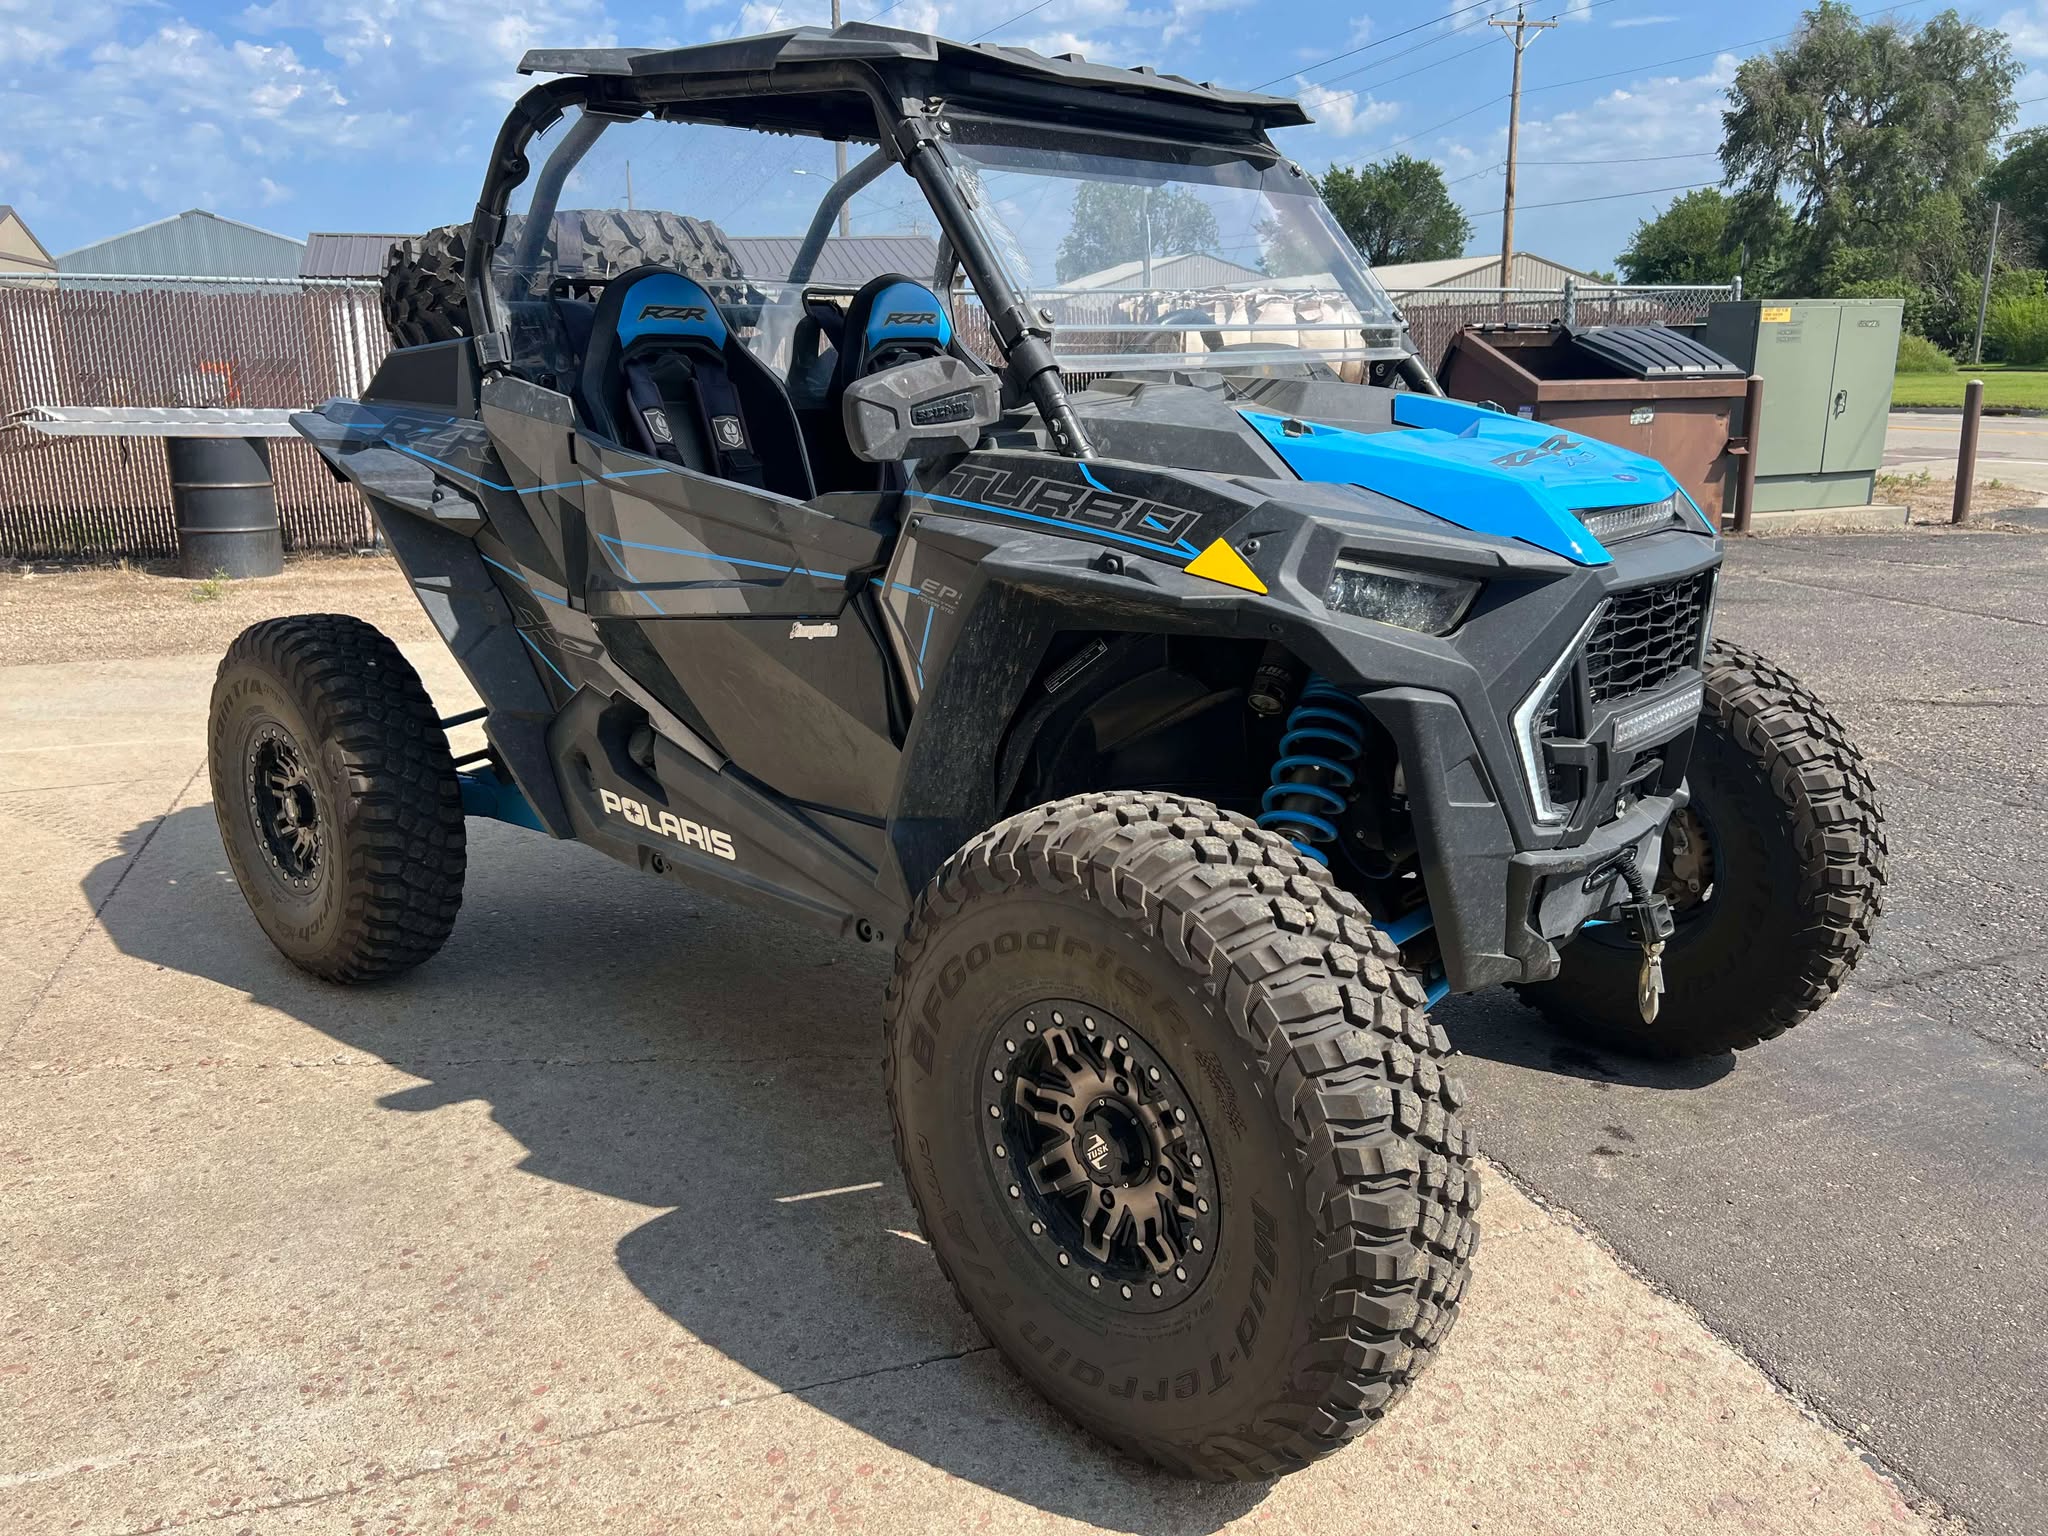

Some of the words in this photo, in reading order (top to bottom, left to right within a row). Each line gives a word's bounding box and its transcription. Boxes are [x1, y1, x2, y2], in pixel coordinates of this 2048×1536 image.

[638, 304, 707, 323] RZR
[883, 311, 936, 327] RZR
[378, 415, 494, 465] RZR
[946, 463, 1204, 547] TURBO
[920, 578, 963, 605] EP
[599, 787, 738, 862] POLARIS
[911, 923, 1192, 1077] BFGoodrich
[1086, 1143, 1109, 1161] TUSK
